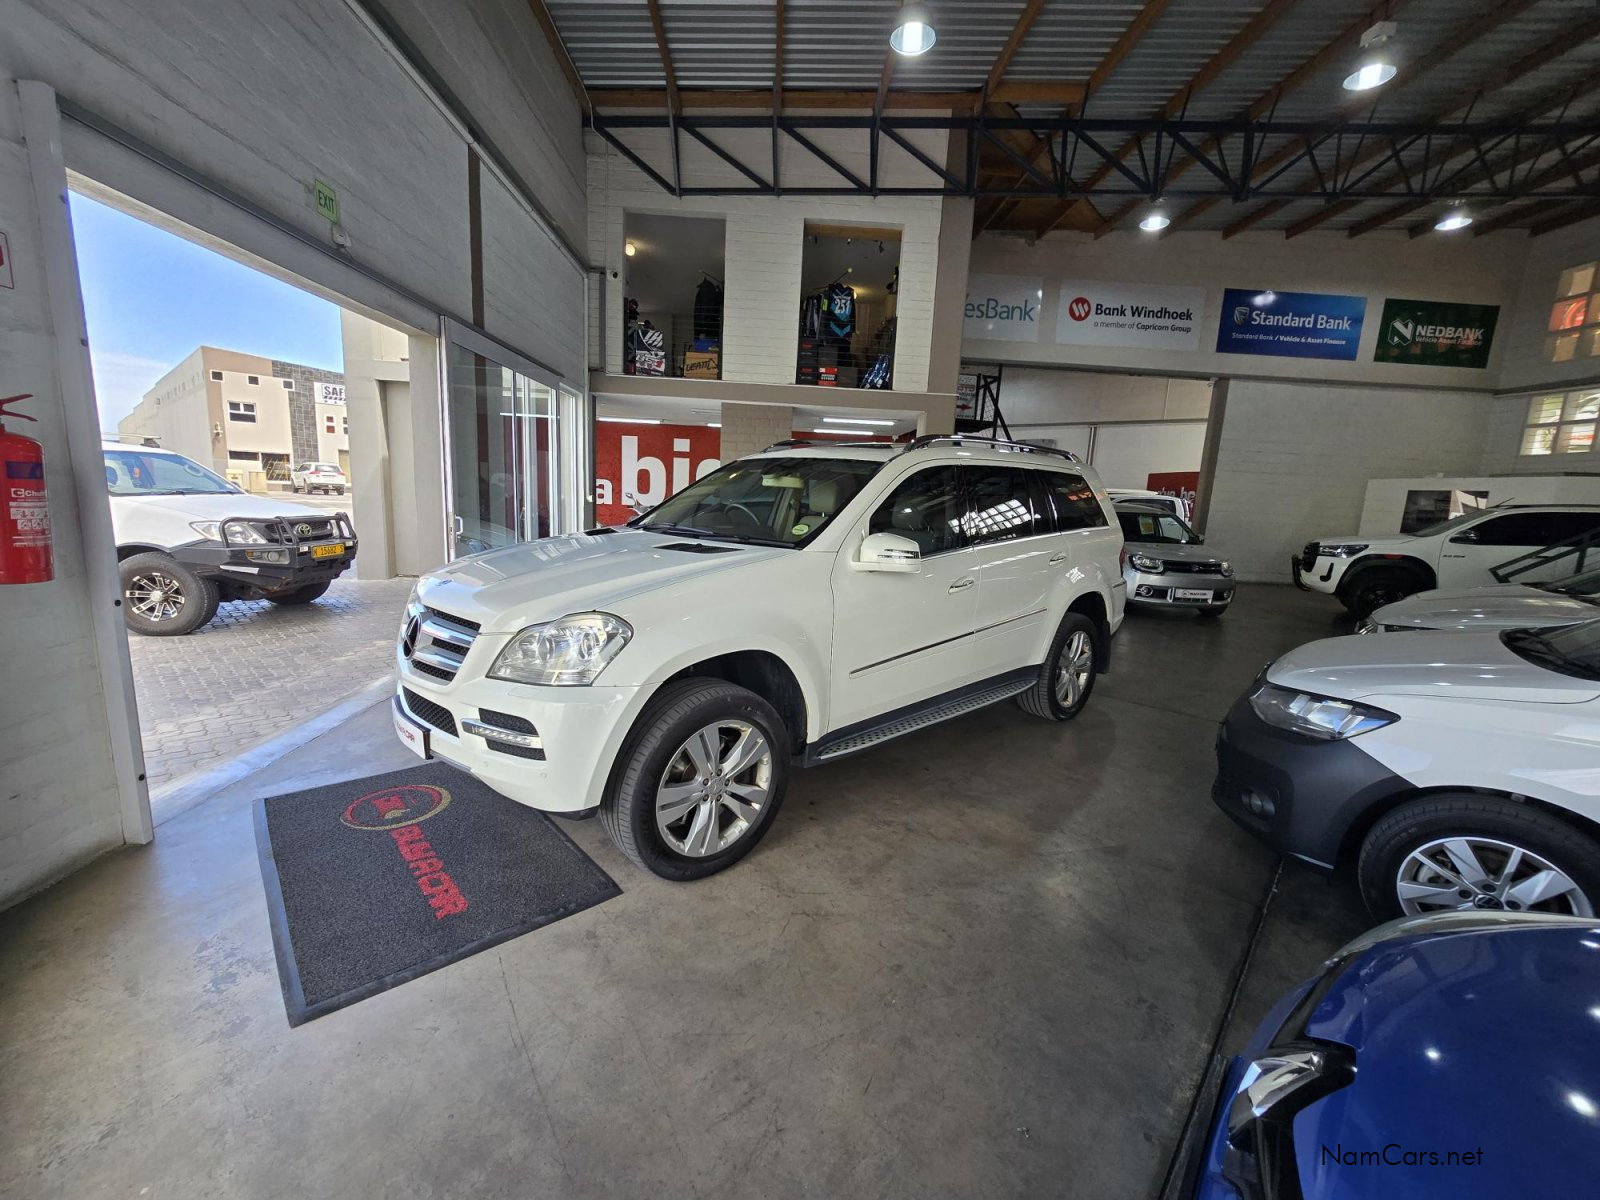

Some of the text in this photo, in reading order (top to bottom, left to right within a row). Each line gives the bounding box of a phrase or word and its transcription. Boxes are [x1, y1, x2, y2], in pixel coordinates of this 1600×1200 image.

[318, 189, 335, 214] EXIT
[965, 292, 1035, 321] esBank
[1095, 303, 1193, 321] Bank Windhoek
[1099, 321, 1127, 329] member
[1128, 322, 1136, 330] of
[1136, 322, 1169, 331] Capricorn
[1170, 324, 1192, 334] Group
[1251, 310, 1352, 330] Standard Bank
[1232, 332, 1258, 340] Standard
[1279, 335, 1300, 343] Vehicle
[1415, 325, 1485, 340] NEDBANK
[621, 434, 721, 507] bi
